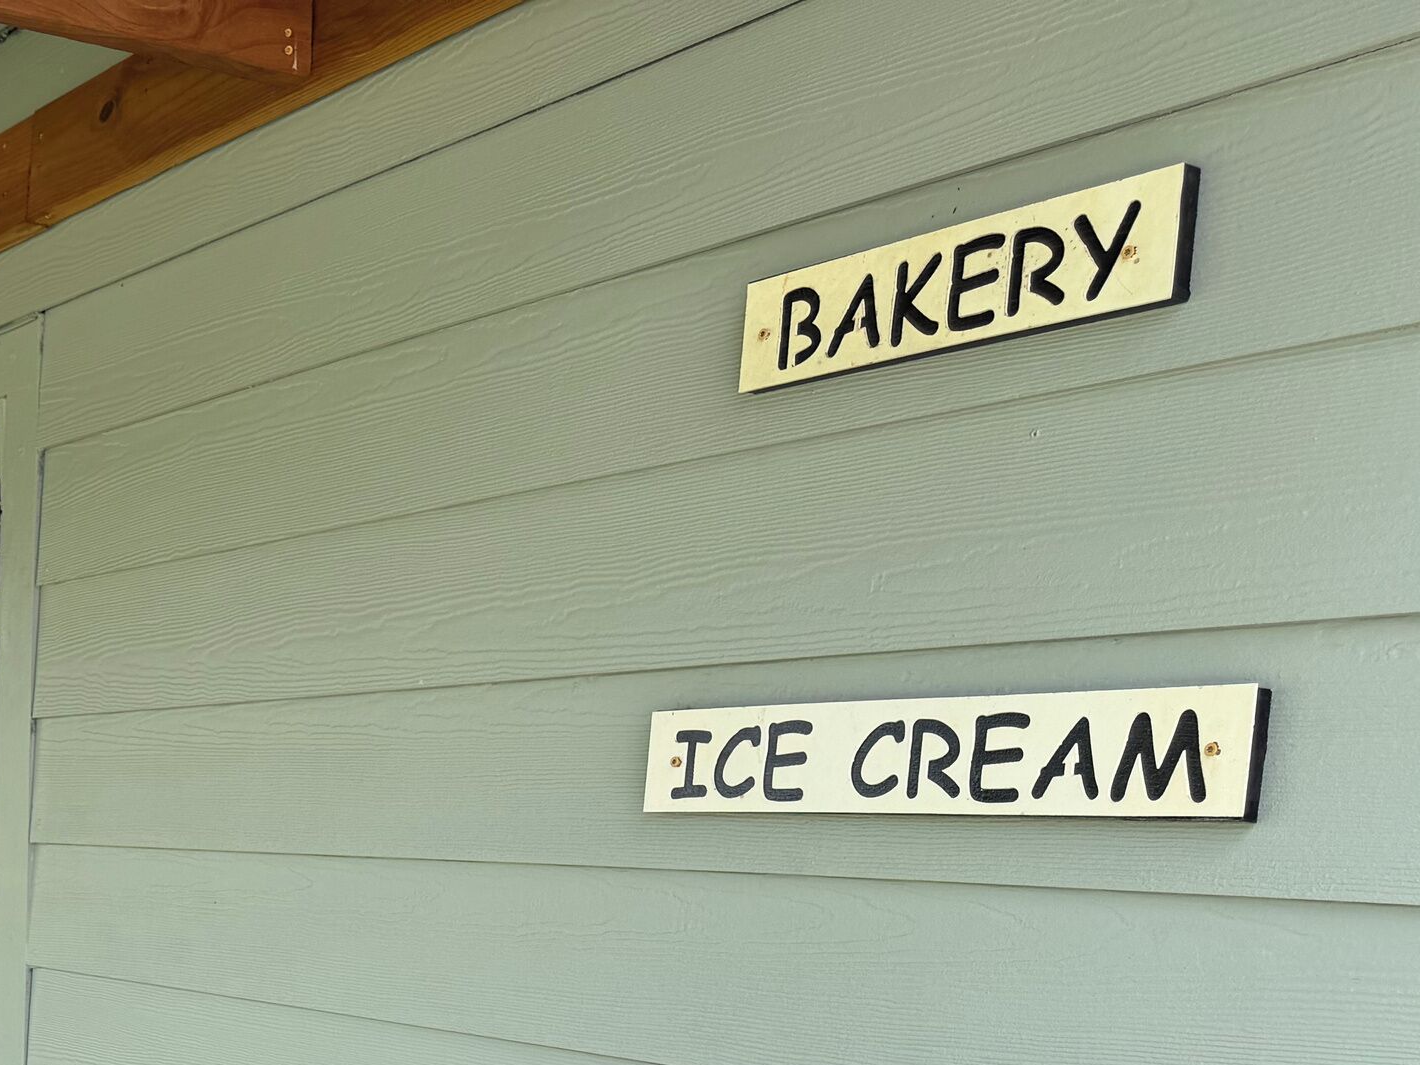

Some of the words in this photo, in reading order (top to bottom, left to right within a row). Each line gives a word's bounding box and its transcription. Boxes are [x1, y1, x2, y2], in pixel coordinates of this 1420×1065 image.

[777, 199, 1142, 371] BAKERY
[670, 719, 814, 801] ICE
[850, 708, 1208, 804] CREAM
